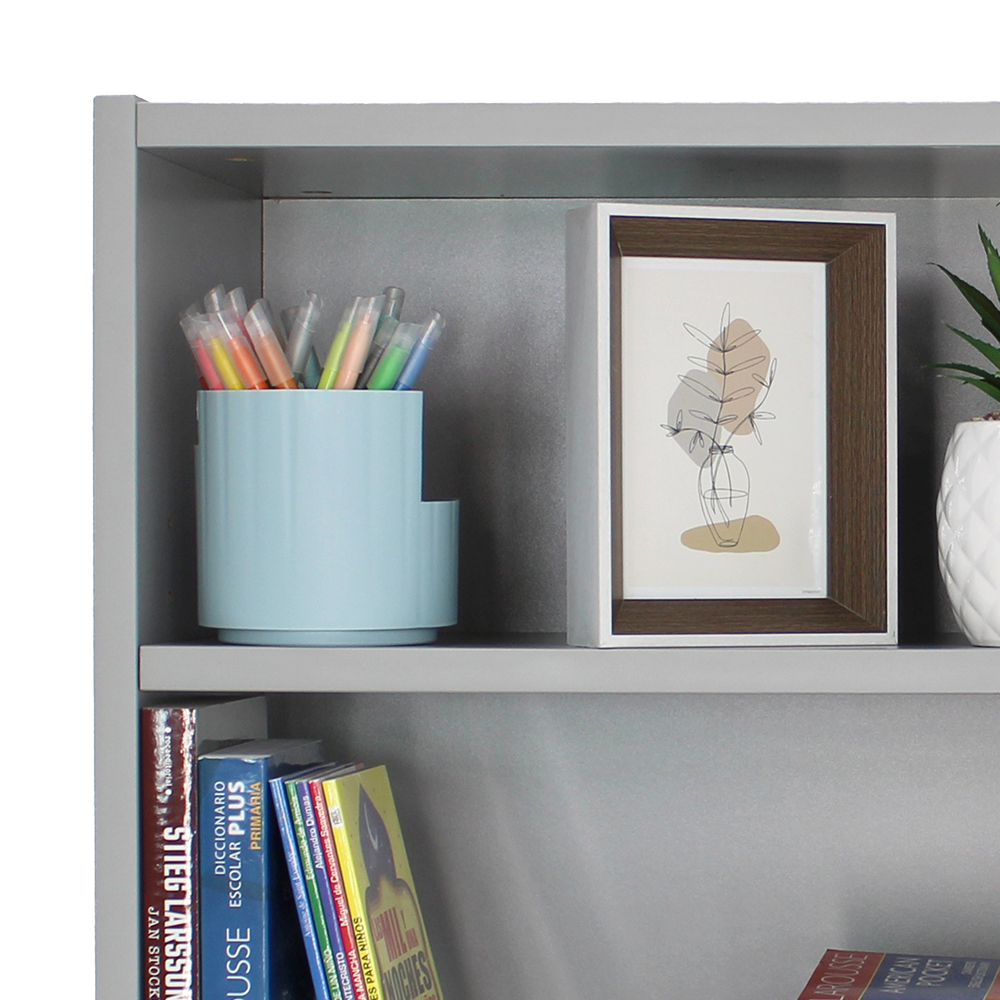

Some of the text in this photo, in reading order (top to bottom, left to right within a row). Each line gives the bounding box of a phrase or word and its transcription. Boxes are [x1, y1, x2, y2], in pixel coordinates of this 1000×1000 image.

[214, 780, 226, 875] DICCIONARIO
[250, 781, 263, 850] PRIMARIA
[303, 796, 323, 870] Alejandro Dumas
[163, 825, 193, 892] STIEG
[228, 780, 245, 908] ESCOLAR PLUS
[324, 838, 338, 883] Cervantes
[332, 884, 341, 896] de
[336, 896, 349, 927] Miguel
[147, 906, 160, 940] JAN
[349, 949, 365, 993] MANCHA
[362, 954, 374, 984] PARA
